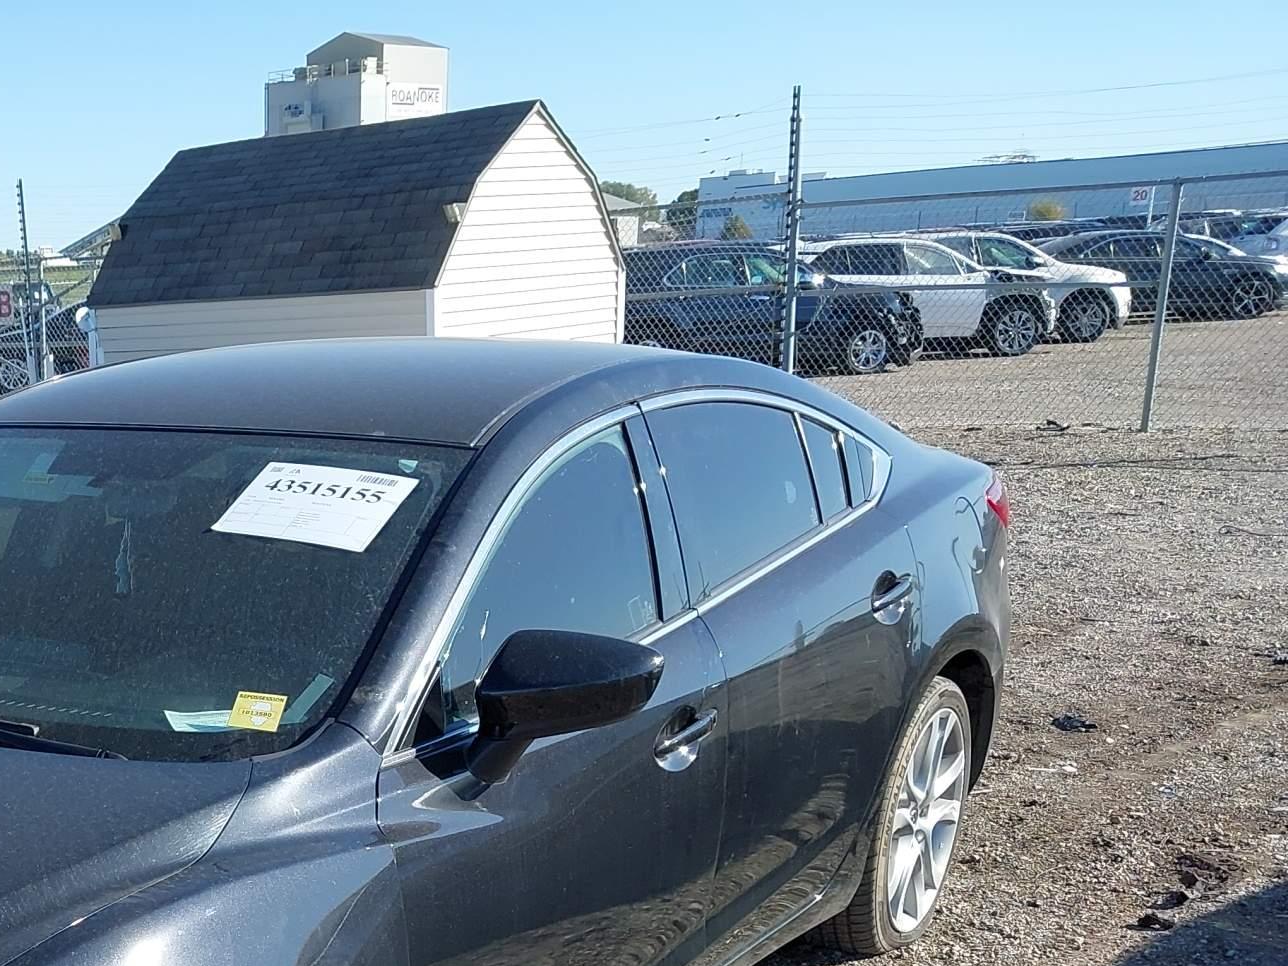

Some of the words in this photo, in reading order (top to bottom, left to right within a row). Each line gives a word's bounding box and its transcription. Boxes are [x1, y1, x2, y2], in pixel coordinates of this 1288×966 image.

[392, 87, 440, 105] ROANOKE
[1133, 190, 1148, 201] 20
[264, 479, 387, 504] 43515155
[239, 693, 285, 703] REPOSSESSION
